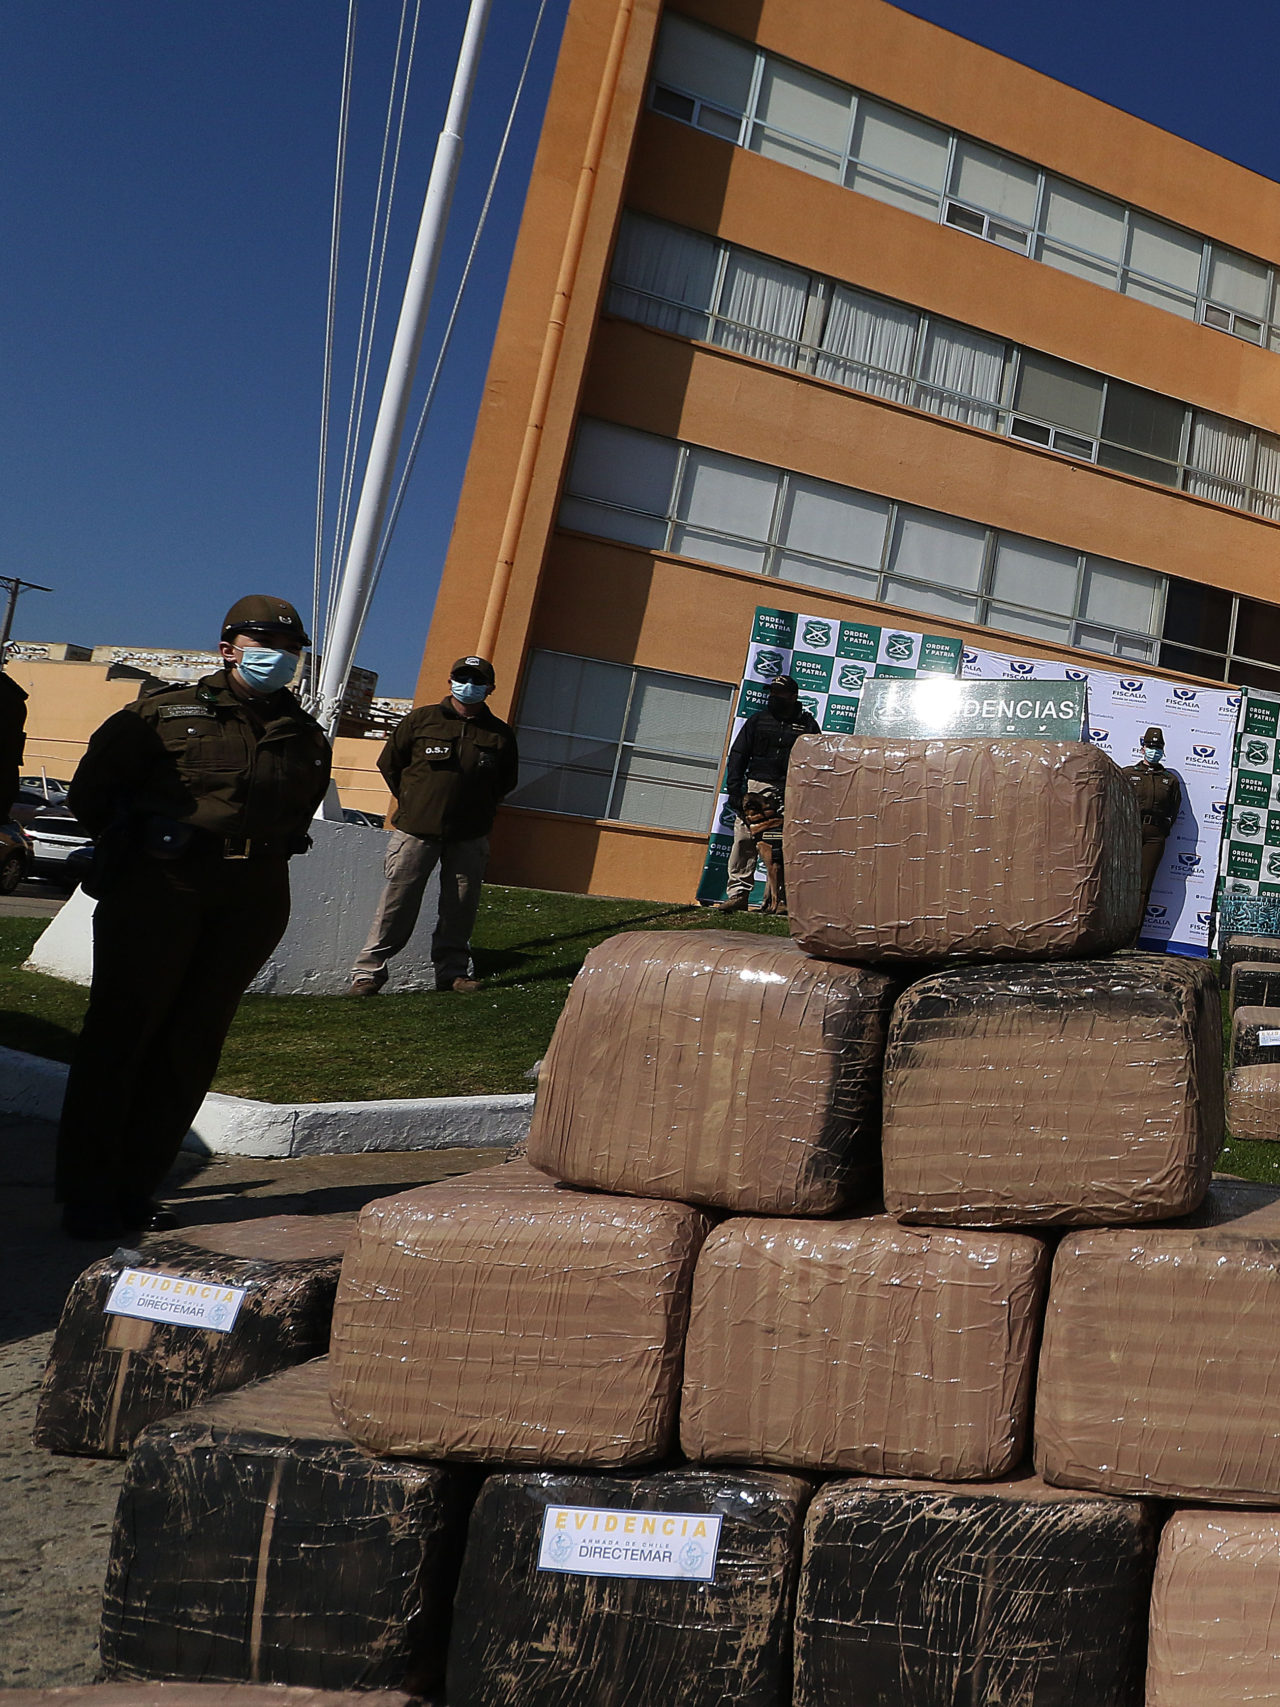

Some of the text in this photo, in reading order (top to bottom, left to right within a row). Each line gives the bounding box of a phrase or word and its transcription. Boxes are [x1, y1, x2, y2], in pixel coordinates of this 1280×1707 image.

[760, 615, 784, 624] ORDEN
[765, 623, 791, 632] PATRIA
[844, 630, 868, 638] ORDEN
[850, 638, 874, 646] PATRIA
[931, 650, 954, 658] PATRIA
[796, 661, 821, 669] ORDEN
[802, 669, 827, 677] PATRIA
[1113, 691, 1146, 699] FISCALIA
[1166, 699, 1200, 708] FISCALIA
[1250, 707, 1270, 715] ORDEN
[1186, 756, 1219, 766] FISCALIA
[1171, 865, 1205, 874] FISCALIA
[125, 1273, 235, 1303] EVIDENCIA
[137, 1298, 205, 1317] DIRECTEMAR
[555, 1512, 707, 1538] EVIDENCIA
[578, 1546, 672, 1563] DIRECTEMAR
